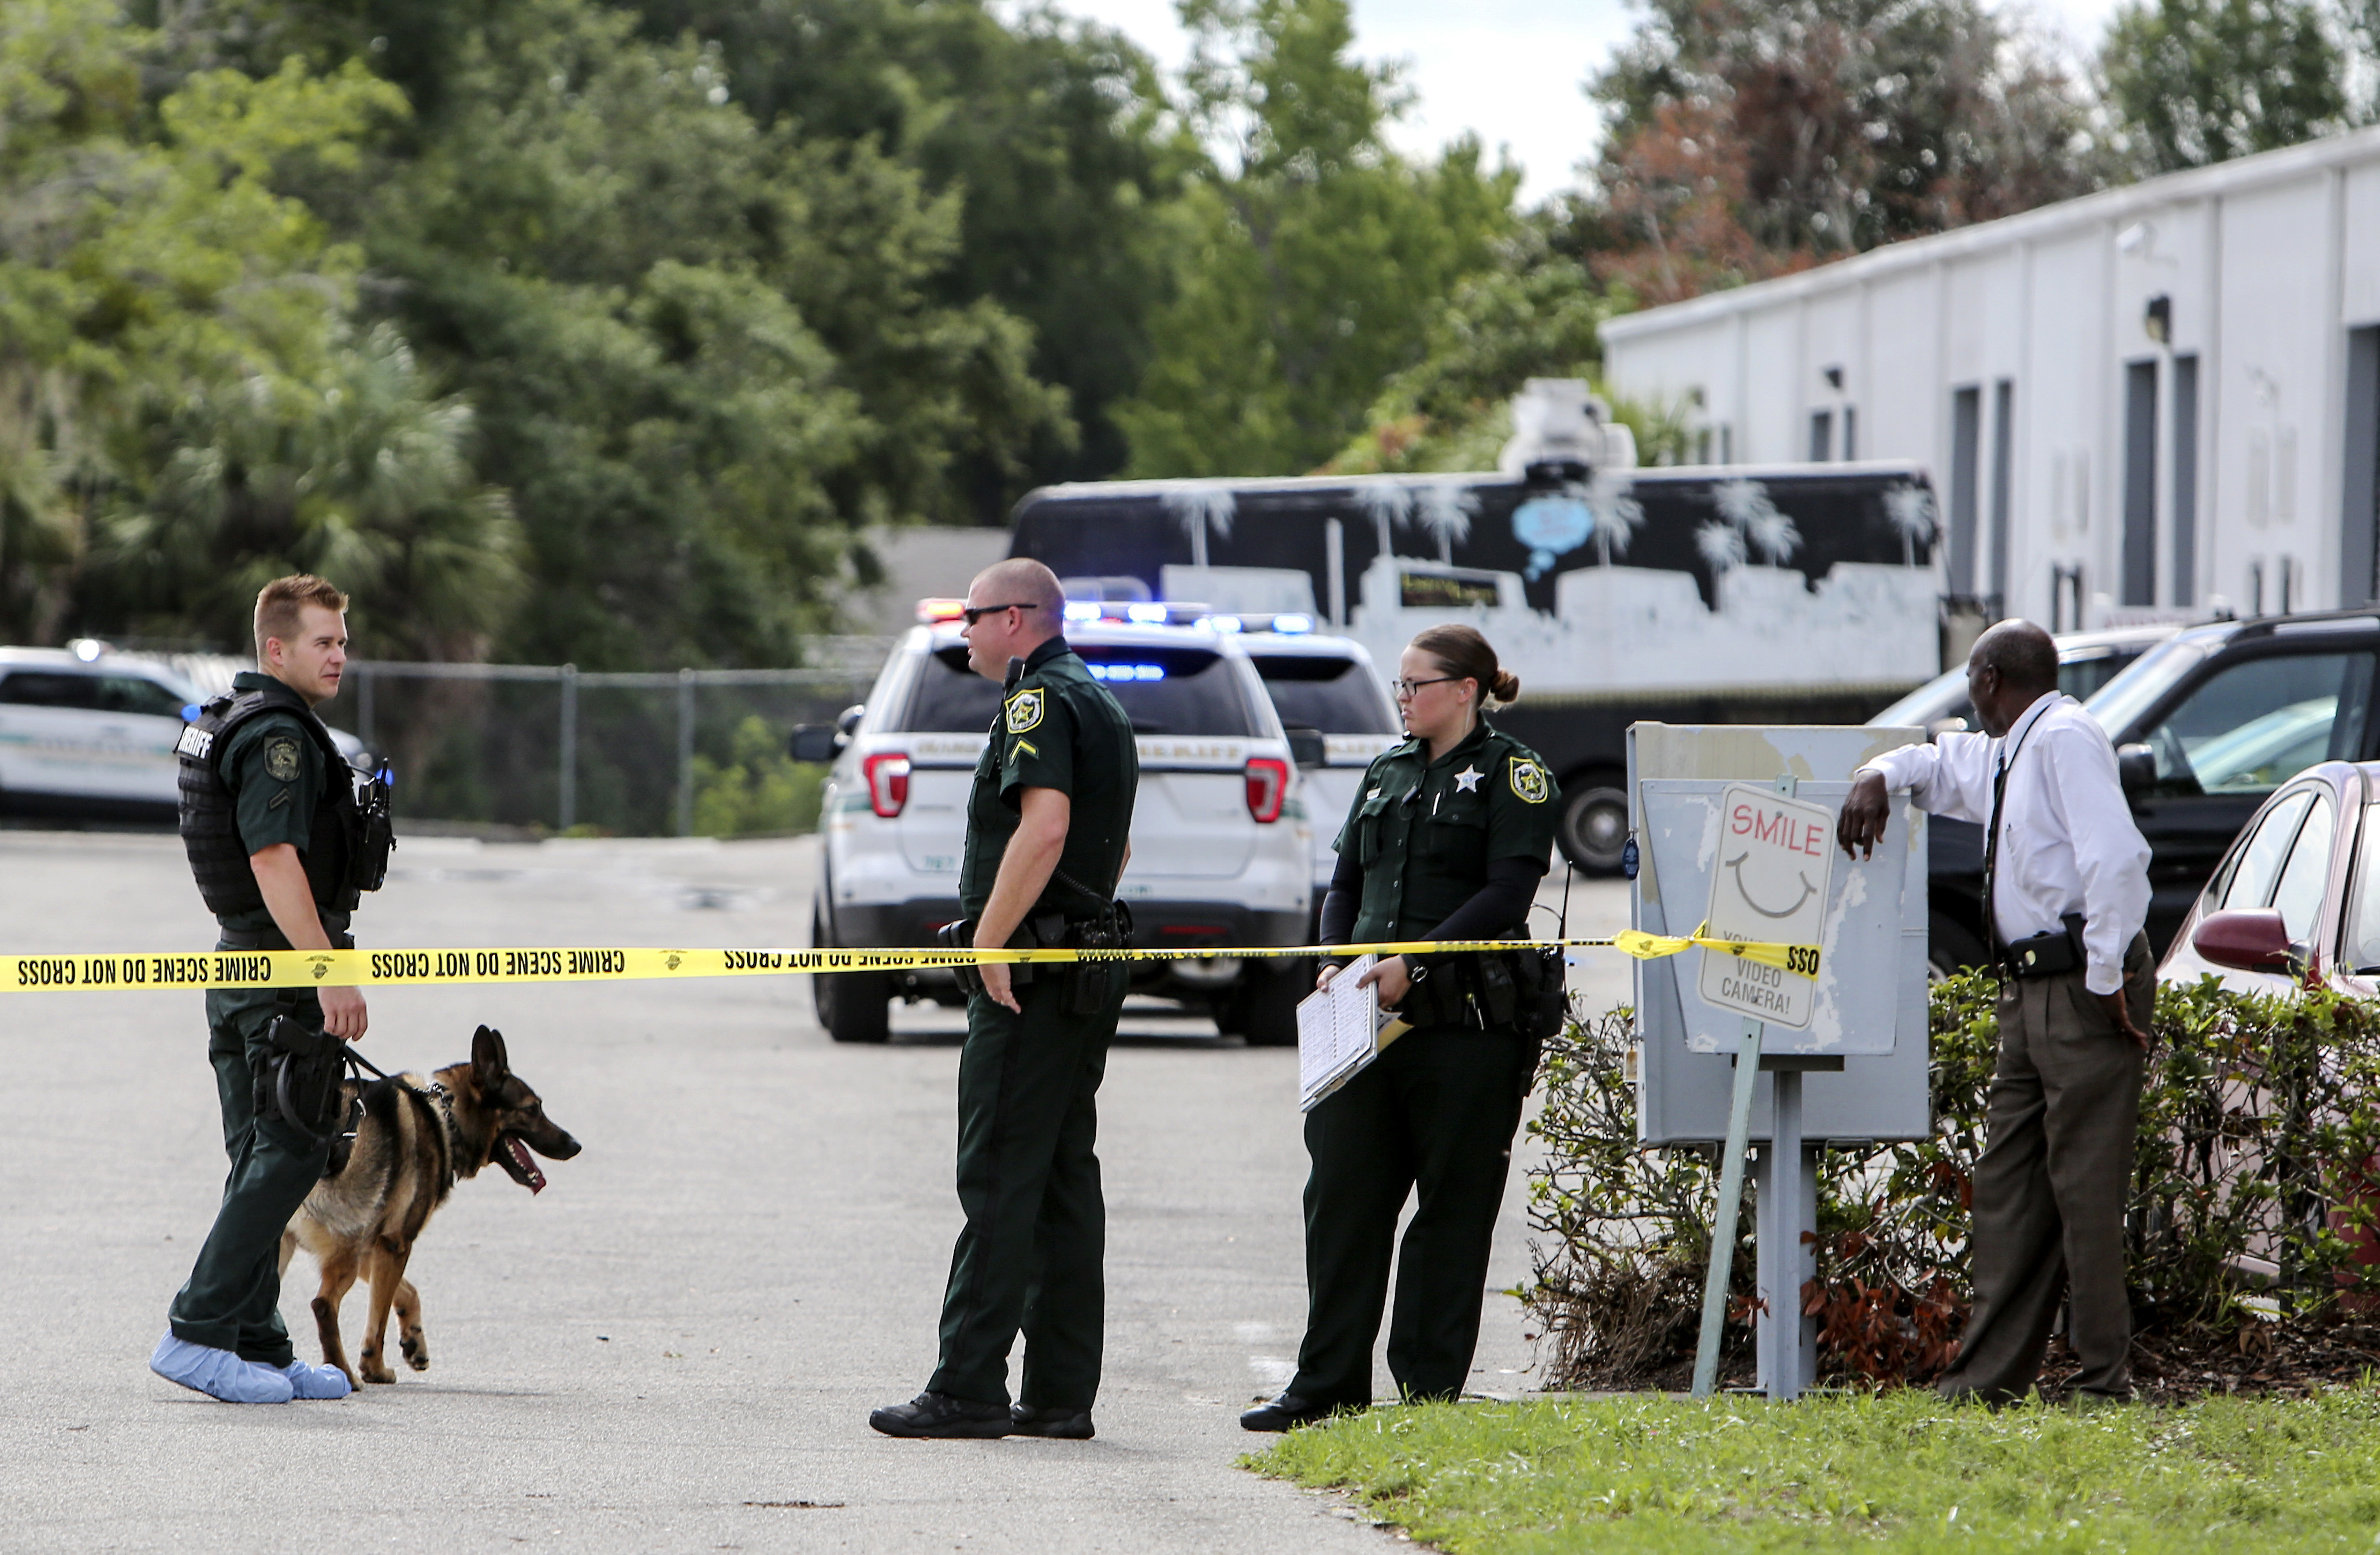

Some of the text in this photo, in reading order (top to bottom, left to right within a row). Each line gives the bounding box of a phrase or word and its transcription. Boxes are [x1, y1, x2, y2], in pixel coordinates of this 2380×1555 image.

[1732, 804, 1824, 856] SMILE
[18, 956, 271, 985] CRIME SCENE DO NOT CROSS
[372, 950, 625, 978] CRIME SCENE DO NOT CROSS
[724, 951, 781, 969] CROSS
[1738, 958, 1781, 988] VIDEO
[1722, 978, 1790, 1014] CAMERA!
